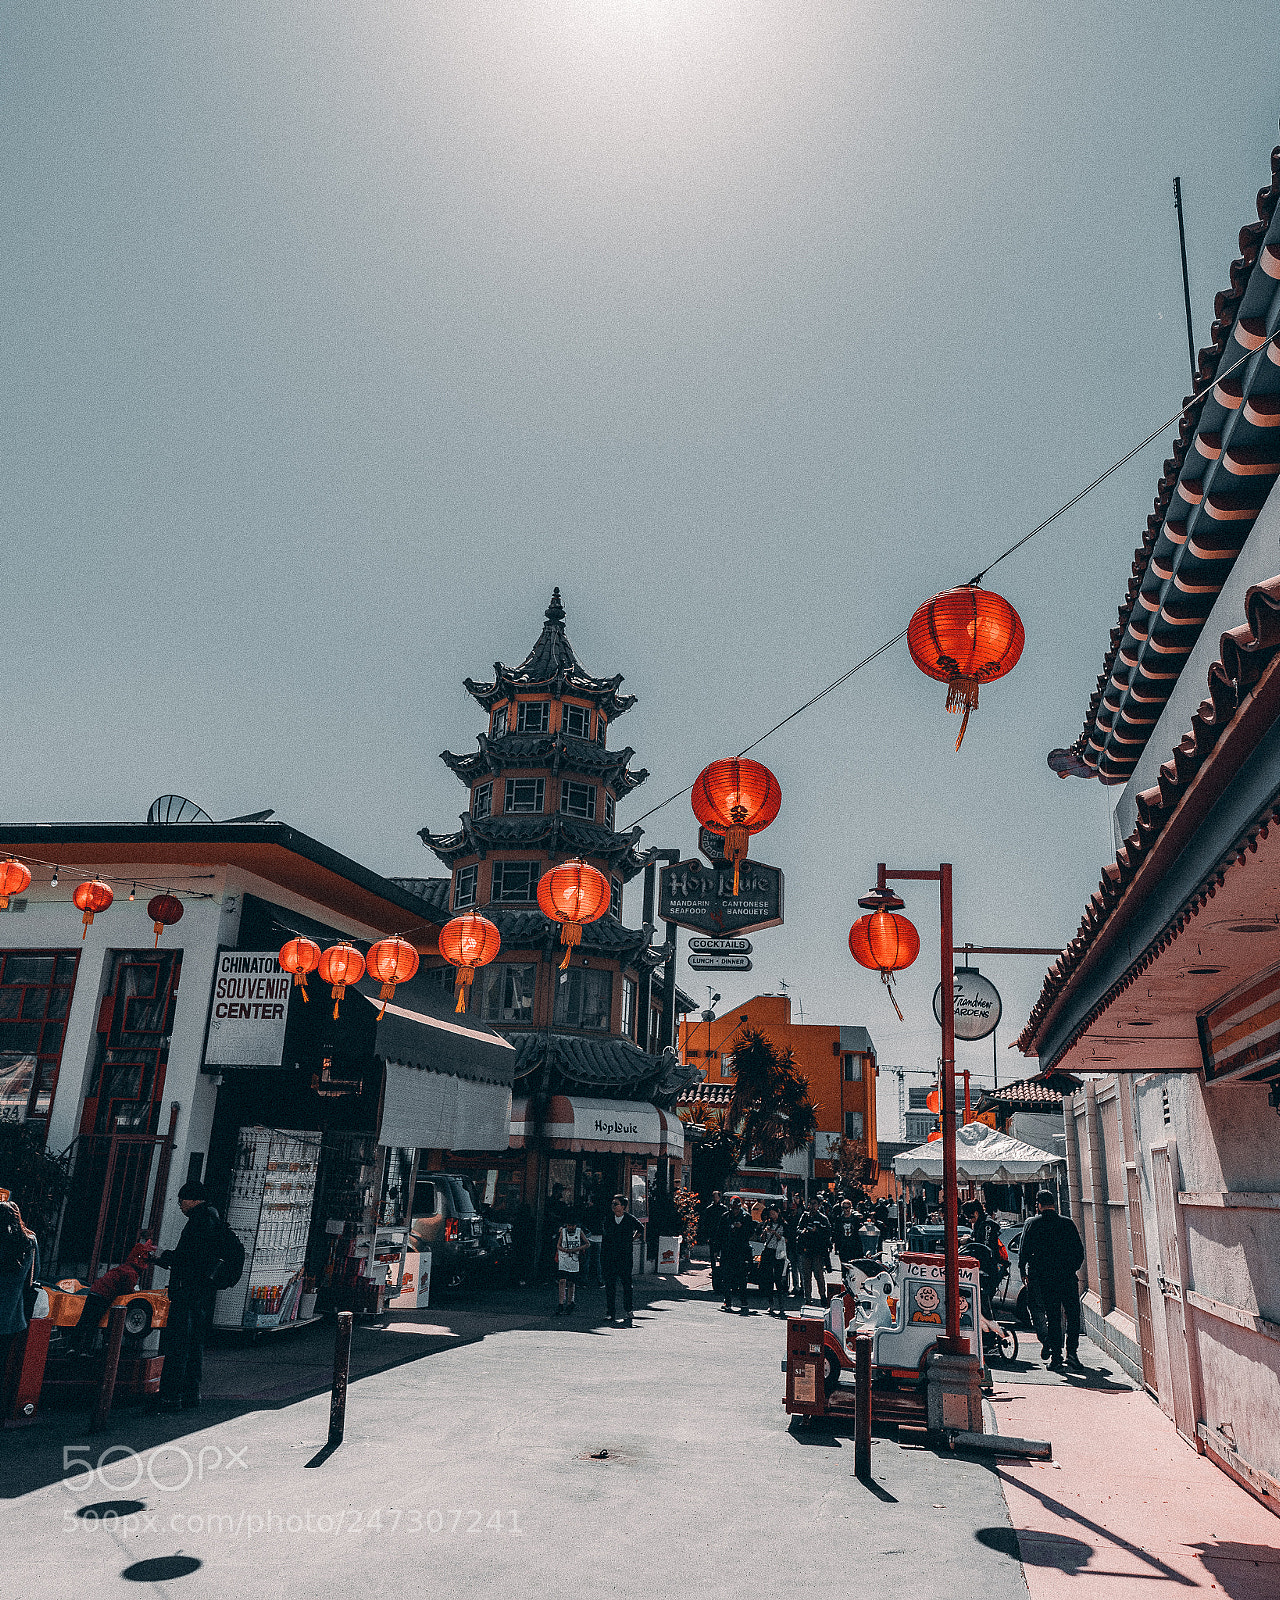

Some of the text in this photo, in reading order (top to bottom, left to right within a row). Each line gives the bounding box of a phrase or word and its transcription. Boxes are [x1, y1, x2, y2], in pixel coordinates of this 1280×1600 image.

[668, 872, 714, 897] Hop
[693, 940, 746, 949] COCKTAILS
[221, 957, 288, 974] CHINATOW
[692, 956, 745, 965] LUNCH DINNER
[216, 977, 290, 1000] SOUVENIR
[215, 1002, 285, 1020] CENTER
[953, 1008, 990, 1018] ARDENS
[908, 1264, 973, 1281] ICE CRAM
